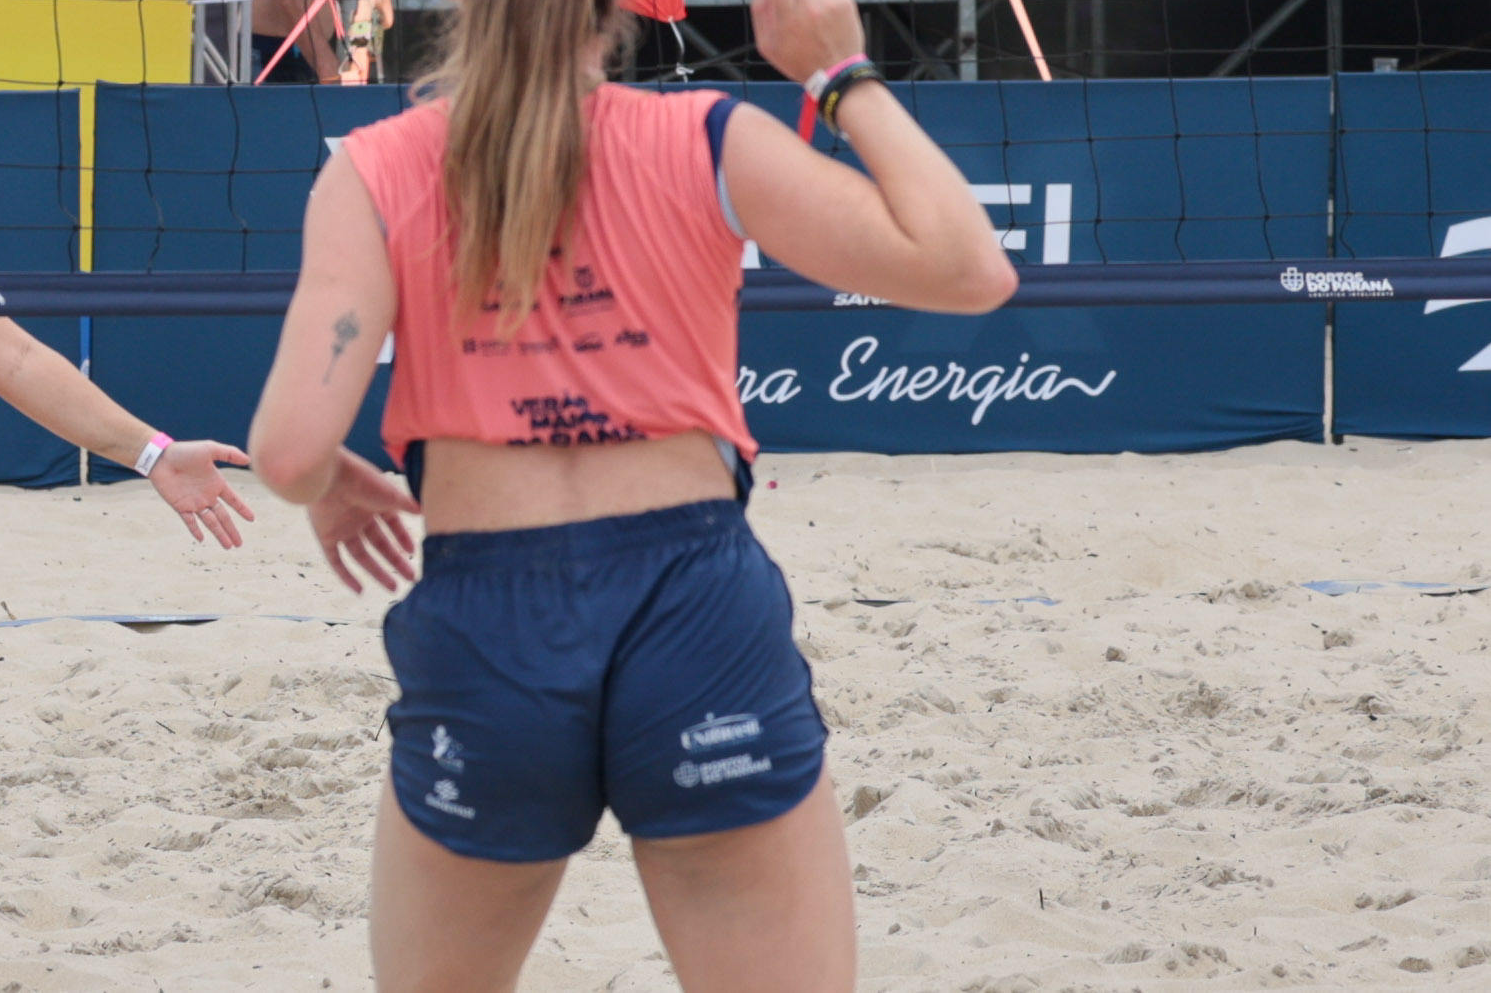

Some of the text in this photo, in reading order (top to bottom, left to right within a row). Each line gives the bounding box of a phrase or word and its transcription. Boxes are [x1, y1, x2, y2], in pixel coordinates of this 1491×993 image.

[1306, 272, 1363, 283] PORTOS
[1307, 278, 1394, 292] DO PARANÁ
[829, 336, 1116, 425] Energia
